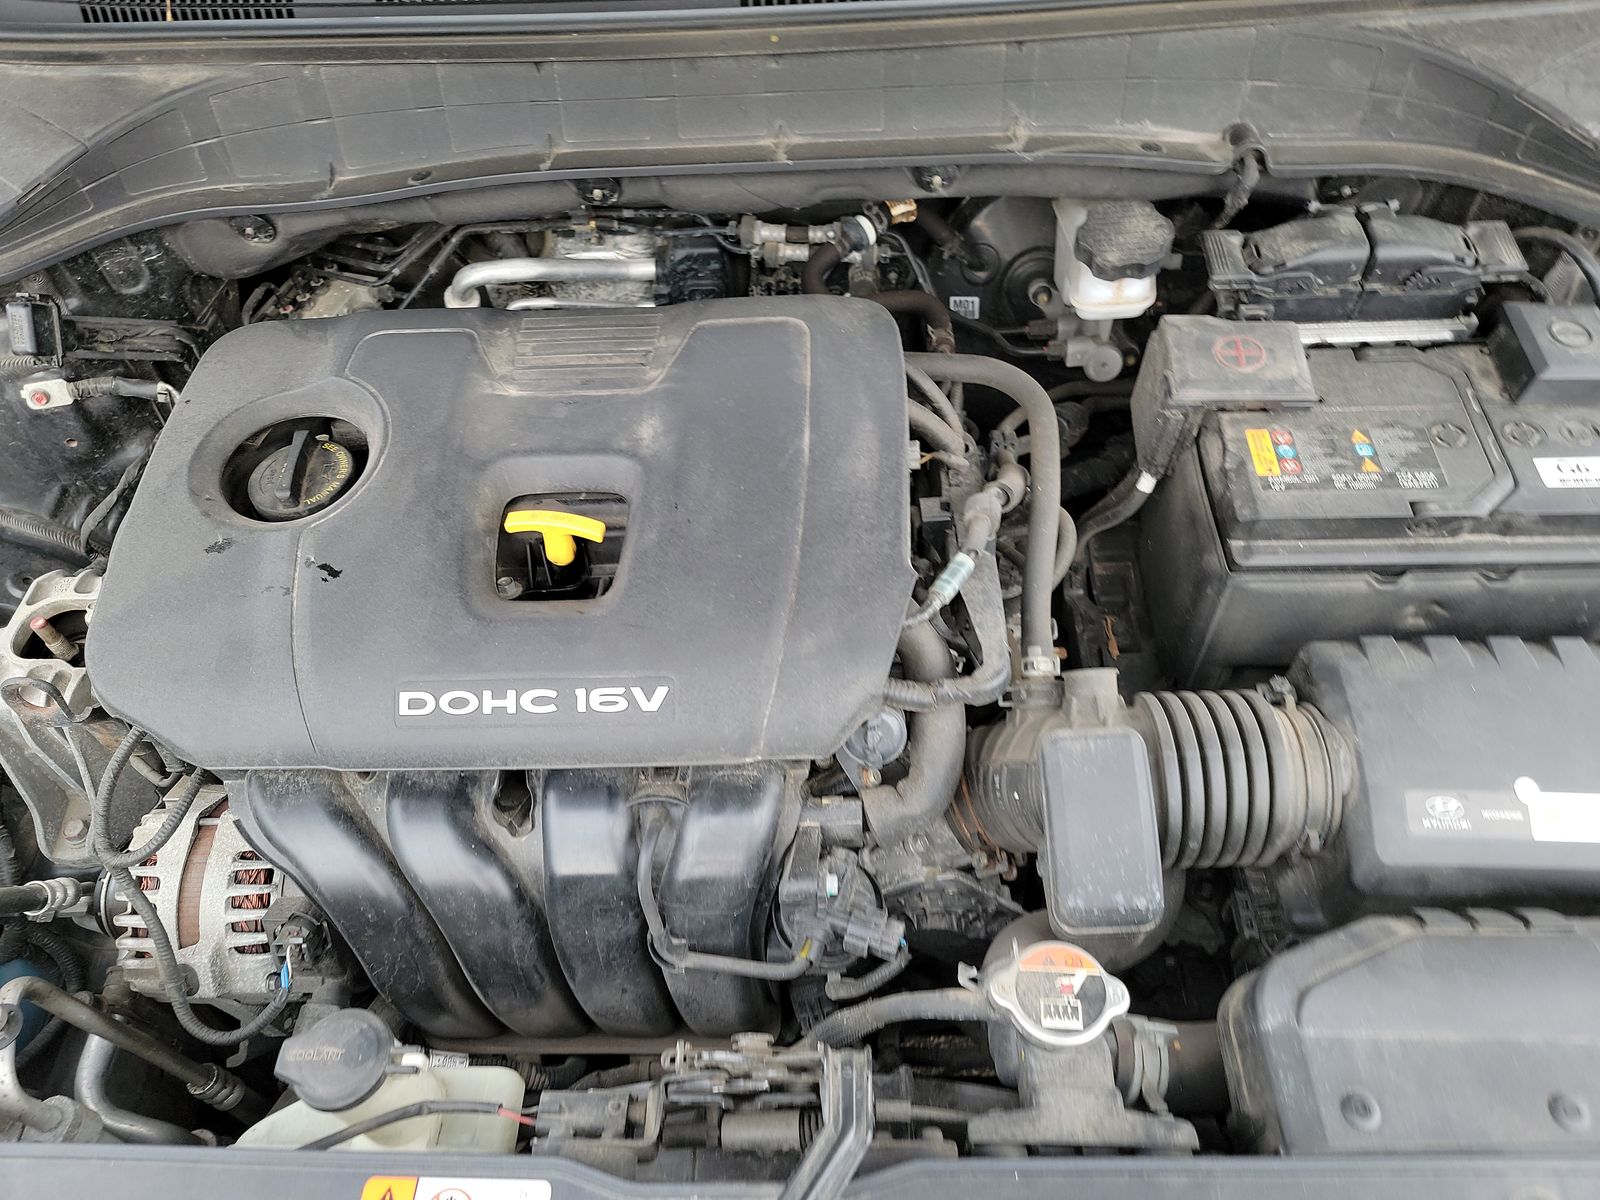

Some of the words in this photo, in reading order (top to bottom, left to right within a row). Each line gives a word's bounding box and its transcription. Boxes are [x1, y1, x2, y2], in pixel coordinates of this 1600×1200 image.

[321, 442, 339, 453] SEE
[303, 481, 340, 504] MANUAL
[398, 688, 559, 716] DOHC
[574, 685, 671, 713] 16V
